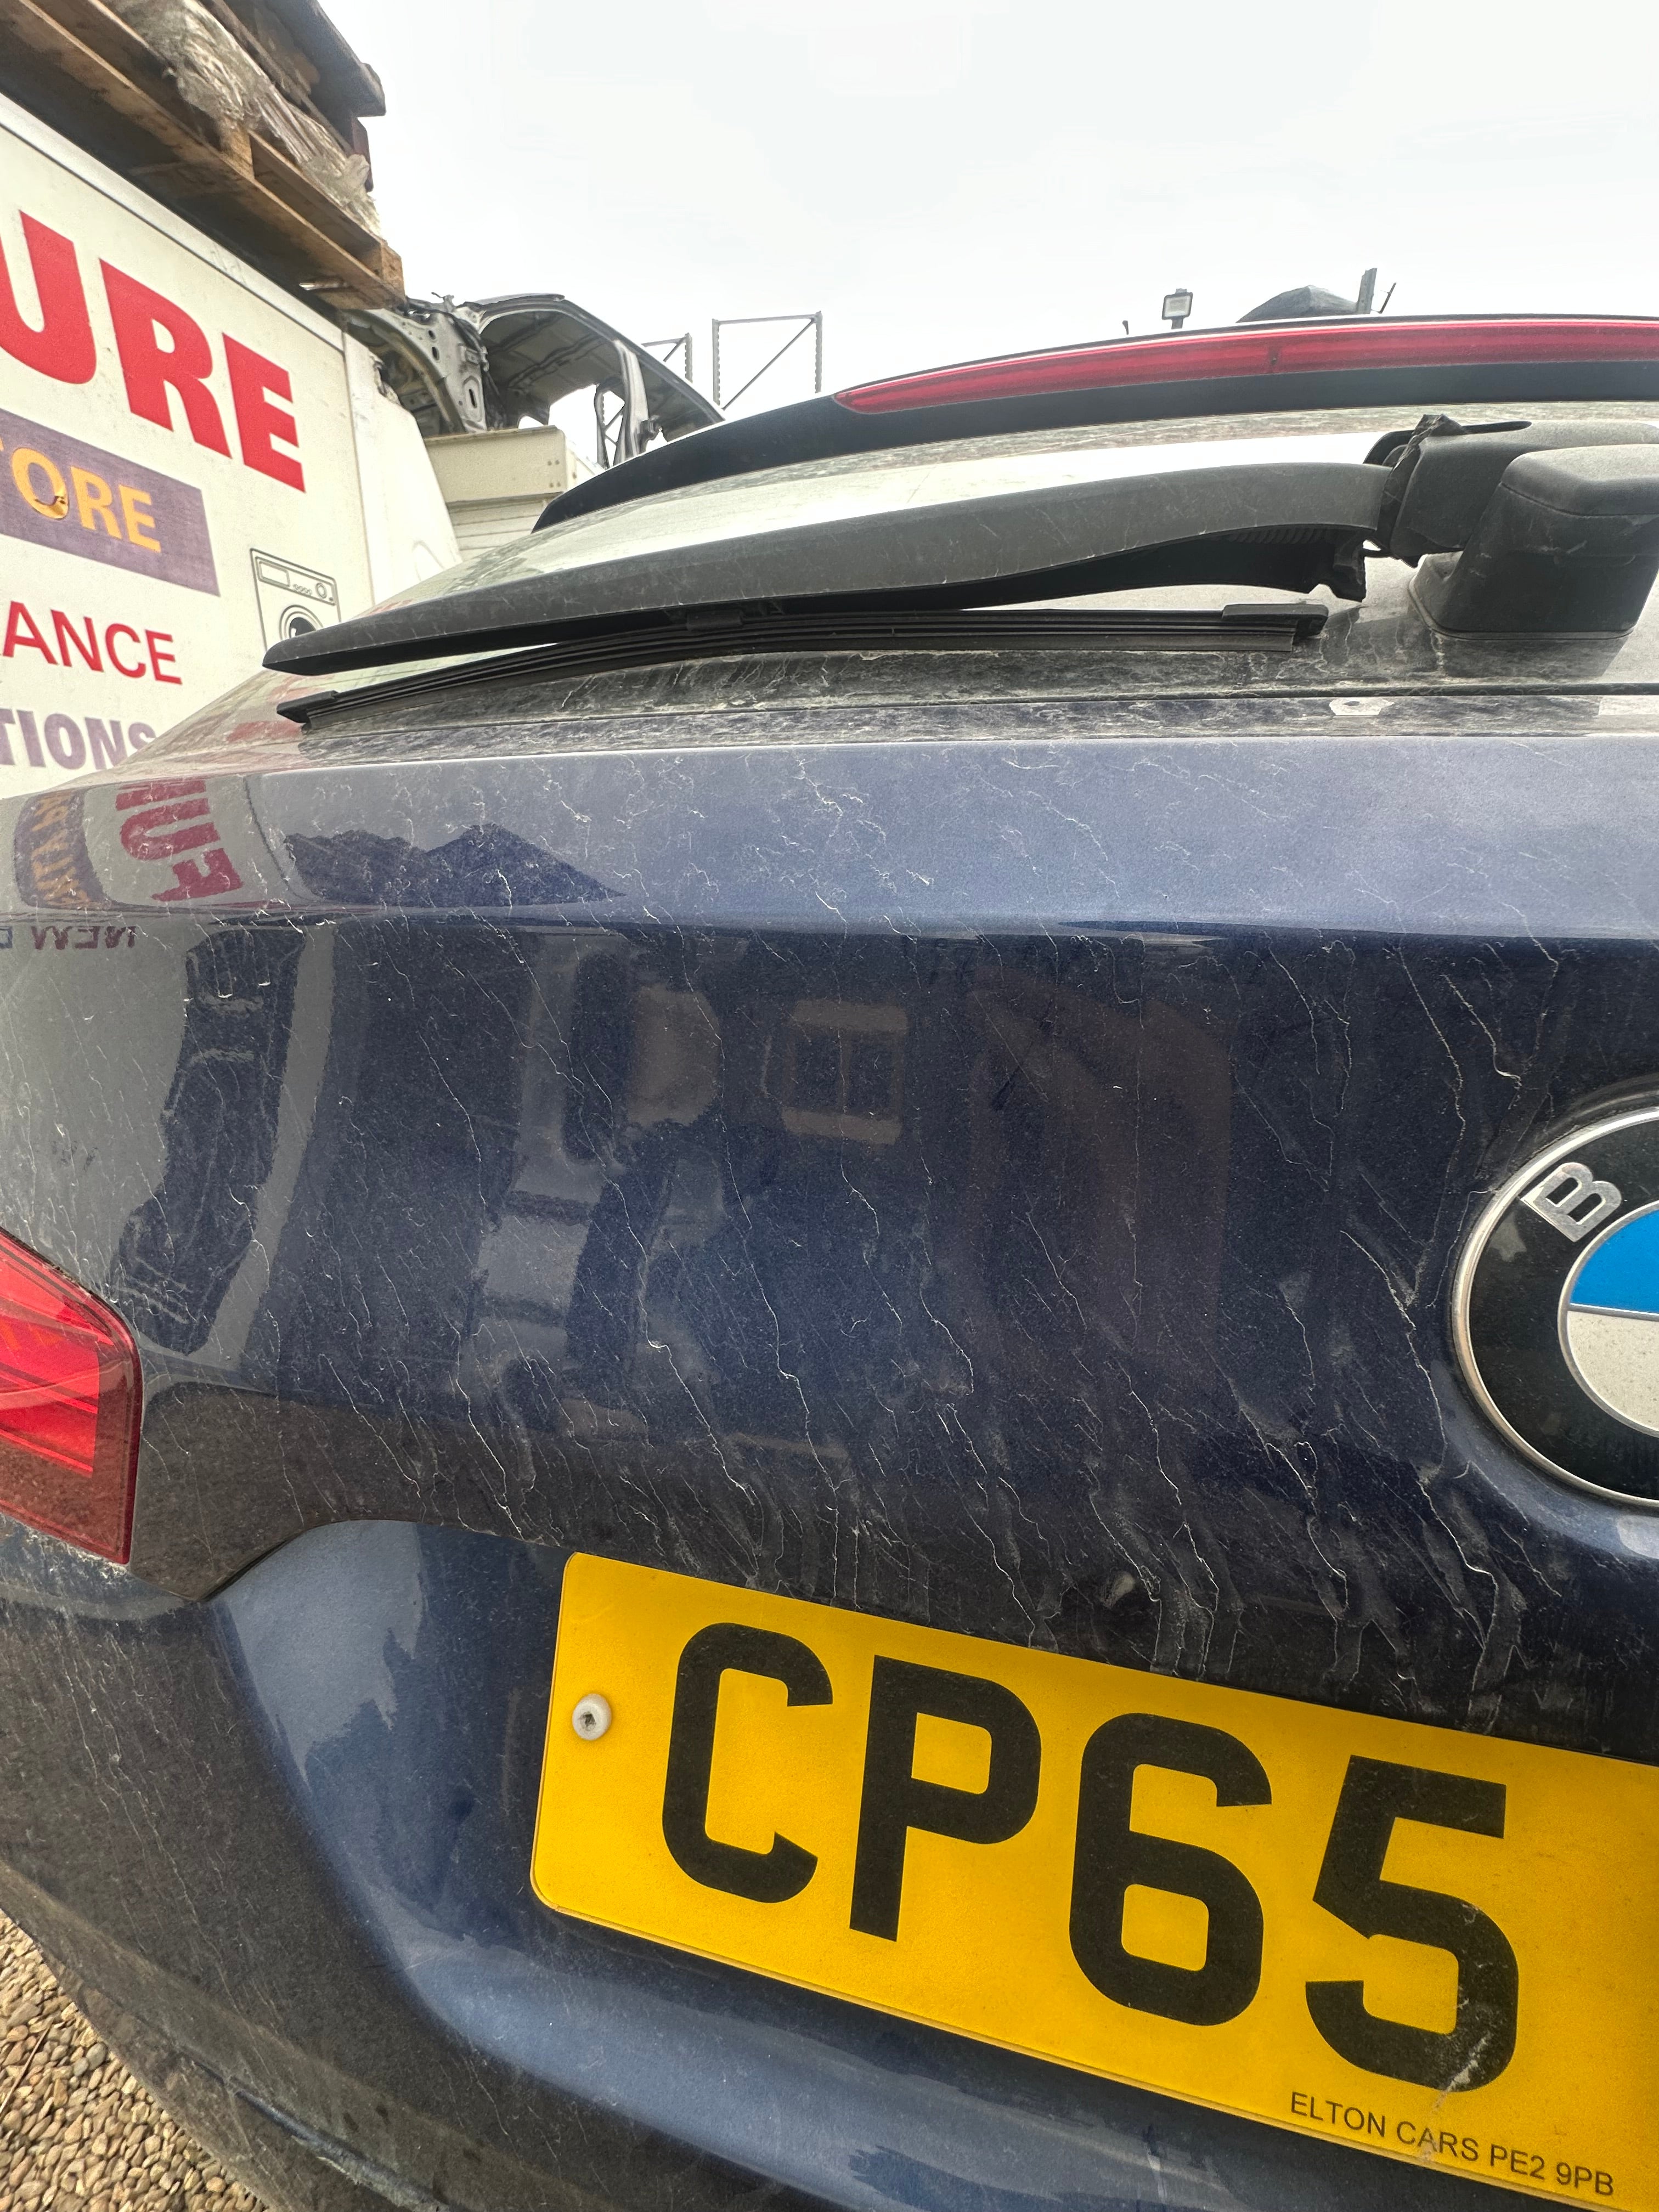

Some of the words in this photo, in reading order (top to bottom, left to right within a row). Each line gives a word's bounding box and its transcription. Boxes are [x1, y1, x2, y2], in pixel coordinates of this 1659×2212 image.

[0, 209, 306, 494] URE
[0, 436, 161, 553] ORE
[2, 600, 183, 685] ANCE
[1520, 1161, 1622, 1243] B
[661, 1622, 1520, 2092] CP65
[1290, 2091, 1386, 2138] ELTON
[1396, 2120, 1480, 2162] CARS
[1489, 2143, 1545, 2181] PE2
[1556, 2162, 1615, 2196] 9PB
